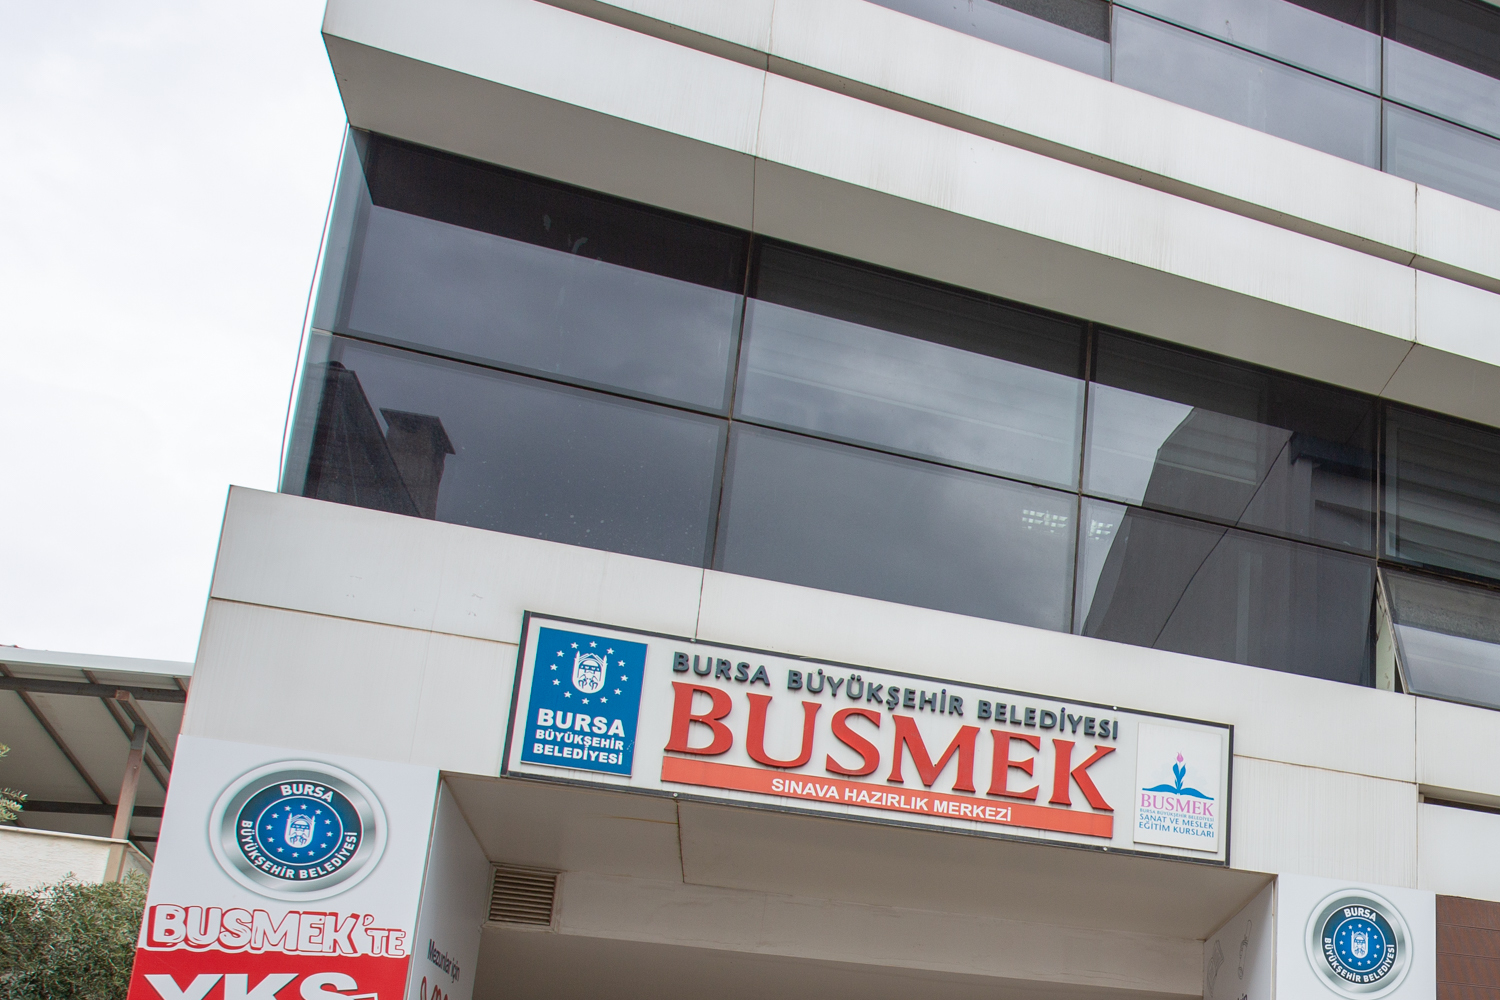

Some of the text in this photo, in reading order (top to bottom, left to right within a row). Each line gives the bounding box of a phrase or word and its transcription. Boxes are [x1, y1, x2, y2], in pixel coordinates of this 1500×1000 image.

[673, 652, 770, 687] BURSA
[787, 669, 964, 716] BÜYÜKŞEHİR
[537, 708, 625, 737] BURSA
[535, 729, 624, 750] BÜYÜKŞEHİR
[663, 681, 1117, 812] BUSMEK
[533, 743, 623, 765] BELEDİYESİ
[280, 784, 334, 802] BURSA
[771, 778, 1012, 822] SINAVA HAZIRLIK MERKEZİ
[1140, 793, 1214, 817] BUSMEK
[1139, 821, 1214, 838] EĞİTİM KURSLARI
[1140, 813, 1214, 830] SANAT VE MESLEK
[240, 820, 358, 879] BÜYÜKŞEHİR BELEDİYESİ
[1344, 907, 1376, 922] BURSA
[428, 938, 452, 977] Mezunlar
[1324, 937, 1395, 983] BÜYÜKŞEHİR BELEDİYESİ
